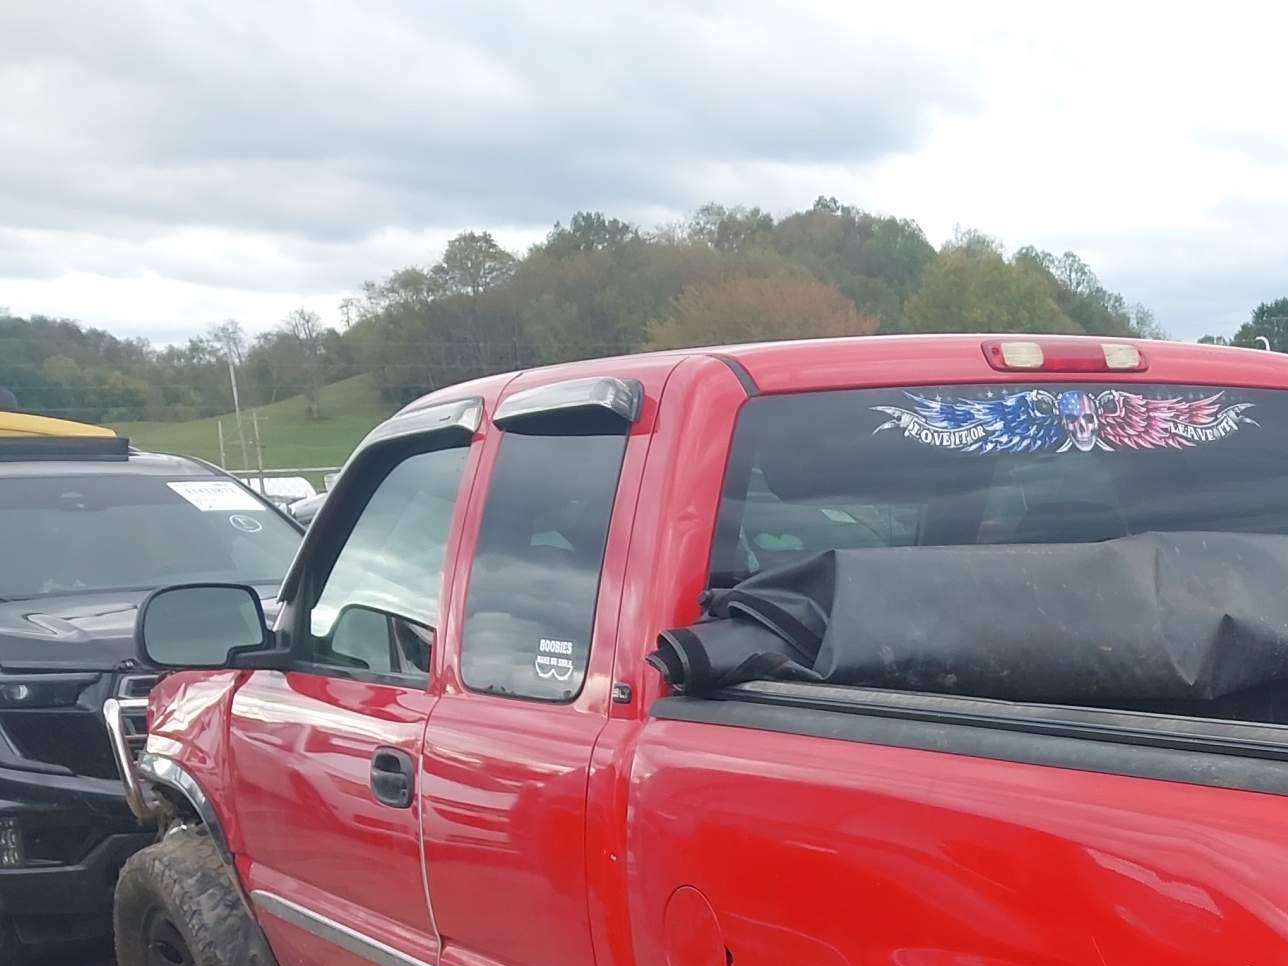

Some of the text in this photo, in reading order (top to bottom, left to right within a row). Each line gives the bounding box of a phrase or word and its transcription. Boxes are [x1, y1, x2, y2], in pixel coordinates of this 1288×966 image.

[908, 422, 986, 446] LOVE IT OR
[1169, 421, 1216, 441] LEAVE
[539, 638, 573, 655] BOOBIES
